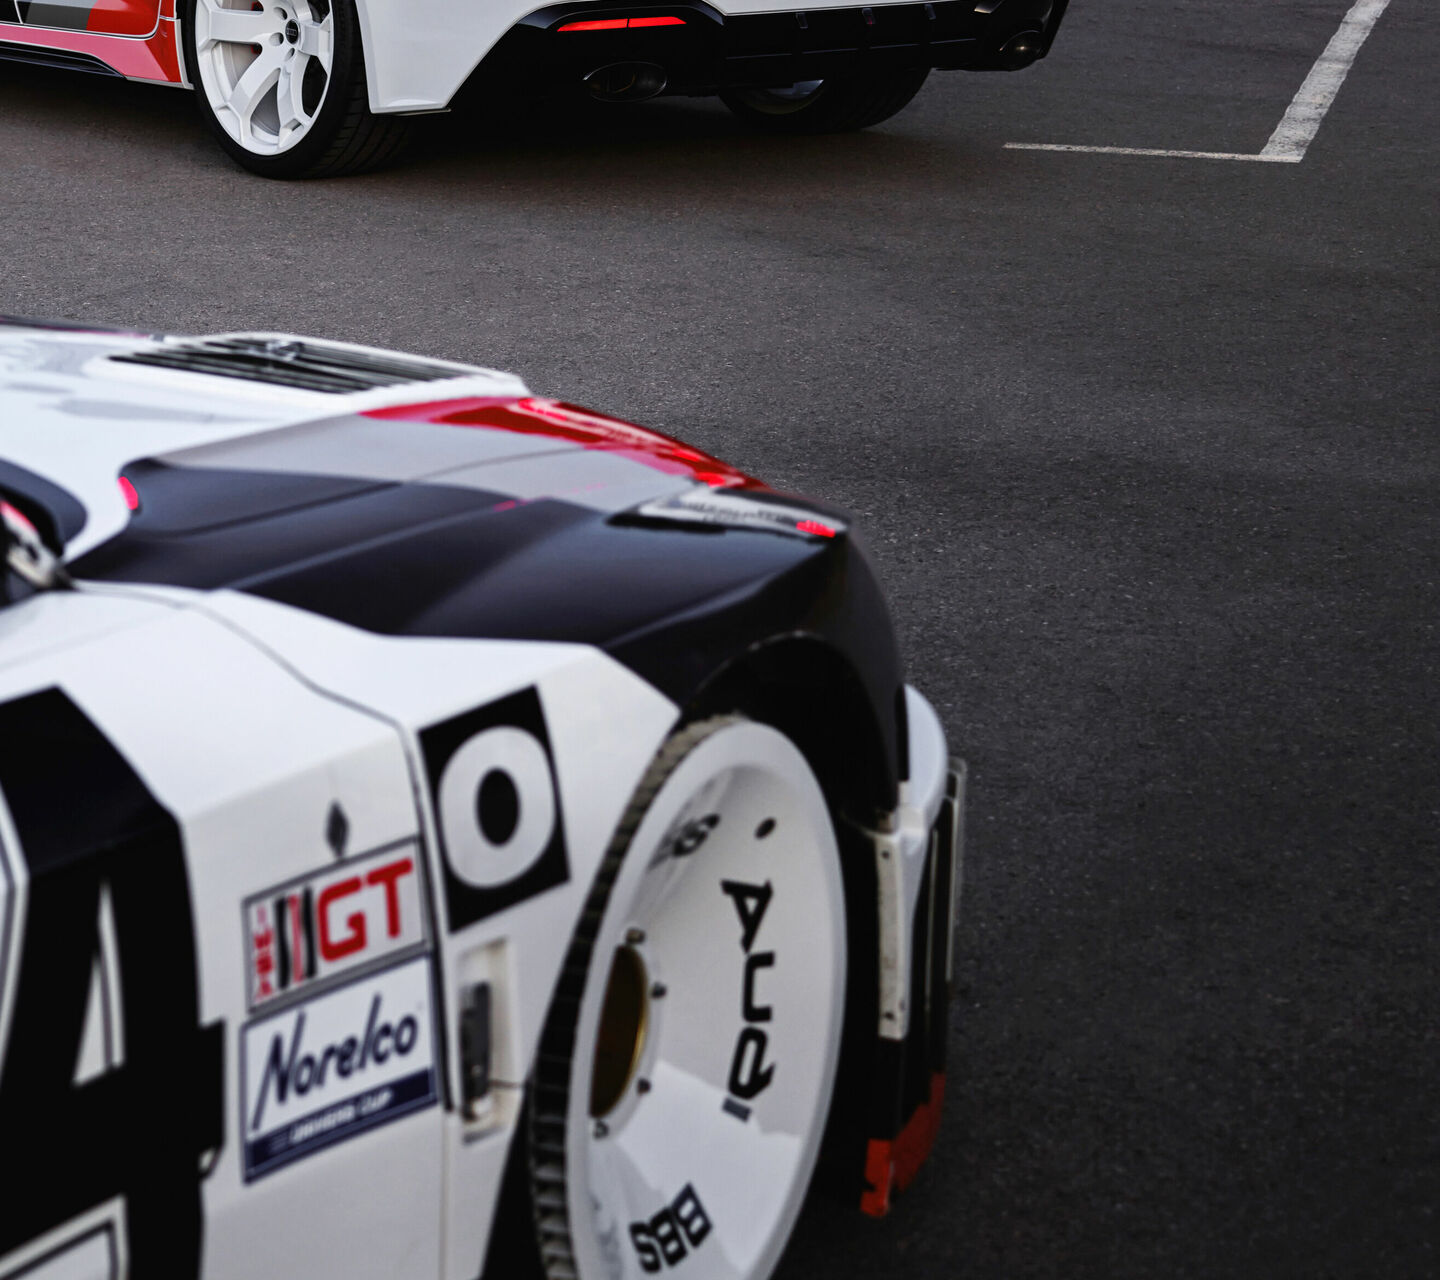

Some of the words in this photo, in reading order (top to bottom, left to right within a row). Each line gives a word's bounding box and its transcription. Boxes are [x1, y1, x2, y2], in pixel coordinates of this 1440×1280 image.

[318, 857, 414, 962] GT
[252, 991, 419, 1132] Norelco
[629, 1182, 713, 1275] BBS
